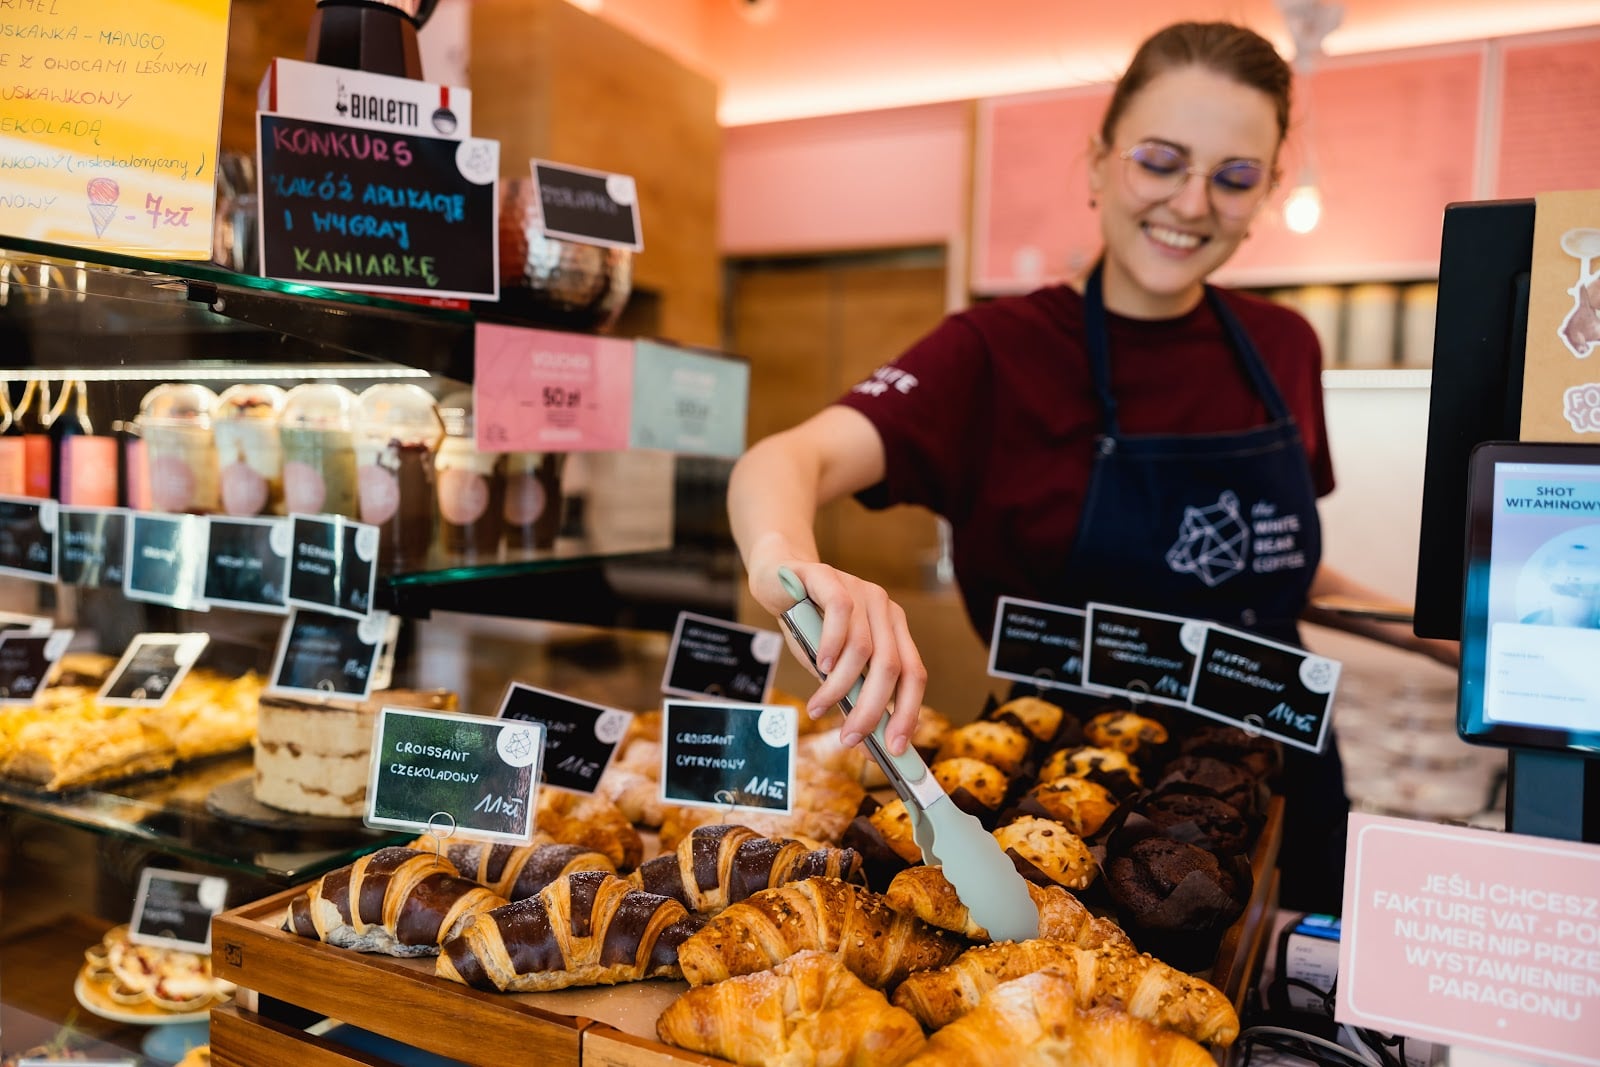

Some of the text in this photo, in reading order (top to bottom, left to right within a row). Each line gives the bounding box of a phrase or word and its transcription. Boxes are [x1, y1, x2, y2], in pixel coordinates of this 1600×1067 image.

[99, 30, 165, 50] MANGO
[44, 58, 127, 74] OWOCAMI
[136, 52, 208, 77] LEŚNYMI
[2, 86, 133, 109] USKAWKOWY
[351, 93, 418, 127] BIALETTI
[272, 126, 413, 167] KONKURS
[284, 209, 293, 231] I
[294, 247, 439, 287] KAWIARKĘ
[1536, 486, 1576, 497] SHOT
[676, 732, 735, 746] CROISSANT
[396, 741, 470, 763] CROISSANT
[676, 753, 746, 770] CYTRYNOWY
[390, 763, 479, 784] CZEKOLADOWY
[1420, 873, 1598, 919] JEŚLI CHCESZ
[1394, 919, 1485, 952] NUMER
[1487, 933, 1531, 957] NIP
[1490, 908, 1539, 935] VAT
[1557, 919, 1600, 946] PO
[1428, 974, 1582, 1021] PARAGONU
